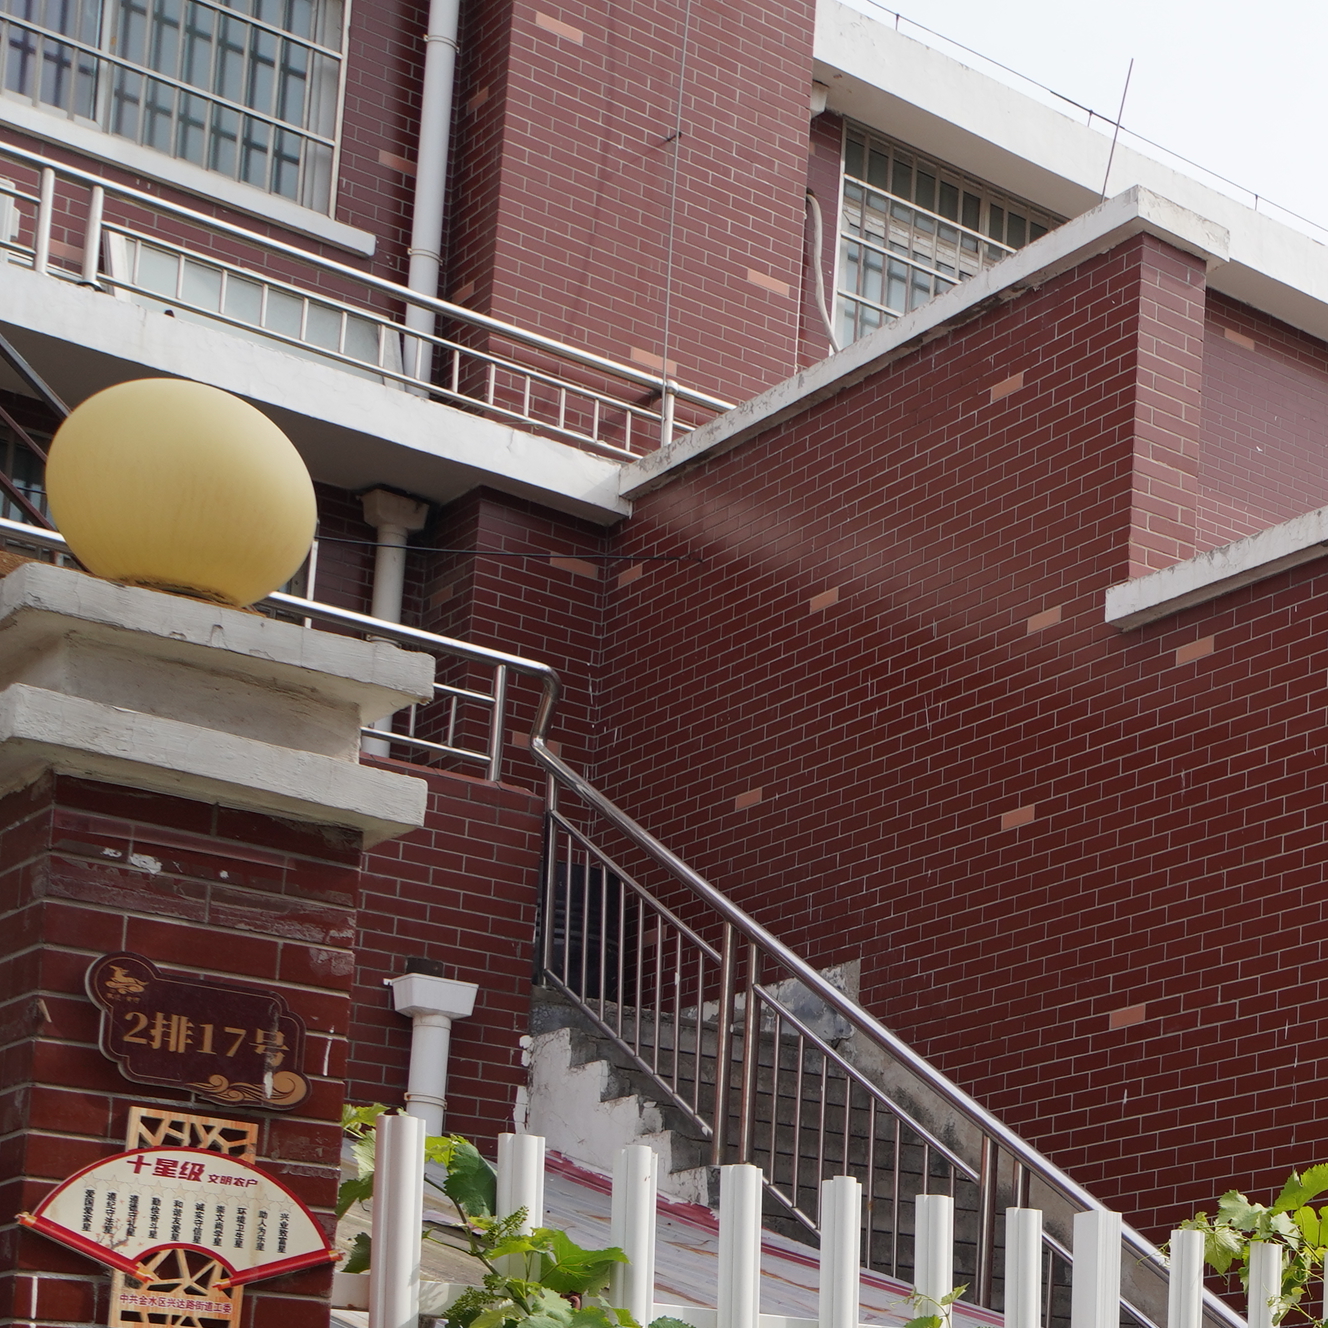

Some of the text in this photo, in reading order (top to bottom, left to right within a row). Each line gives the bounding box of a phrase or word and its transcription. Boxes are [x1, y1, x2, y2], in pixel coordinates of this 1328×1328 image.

[123, 1011, 290, 1067] 2排17号
[126, 1155, 258, 1188] 十星级 文明农户
[192, 1203, 205, 1244] 诚实守信星
[212, 1205, 225, 1246] 崇文尚学星
[234, 1207, 247, 1248] 环境卫生星
[255, 1210, 268, 1251] 助人为乐星
[277, 1213, 290, 1253] 兴业致富星
[120, 1294, 232, 1313] 中共金水区兴达路街道工委
